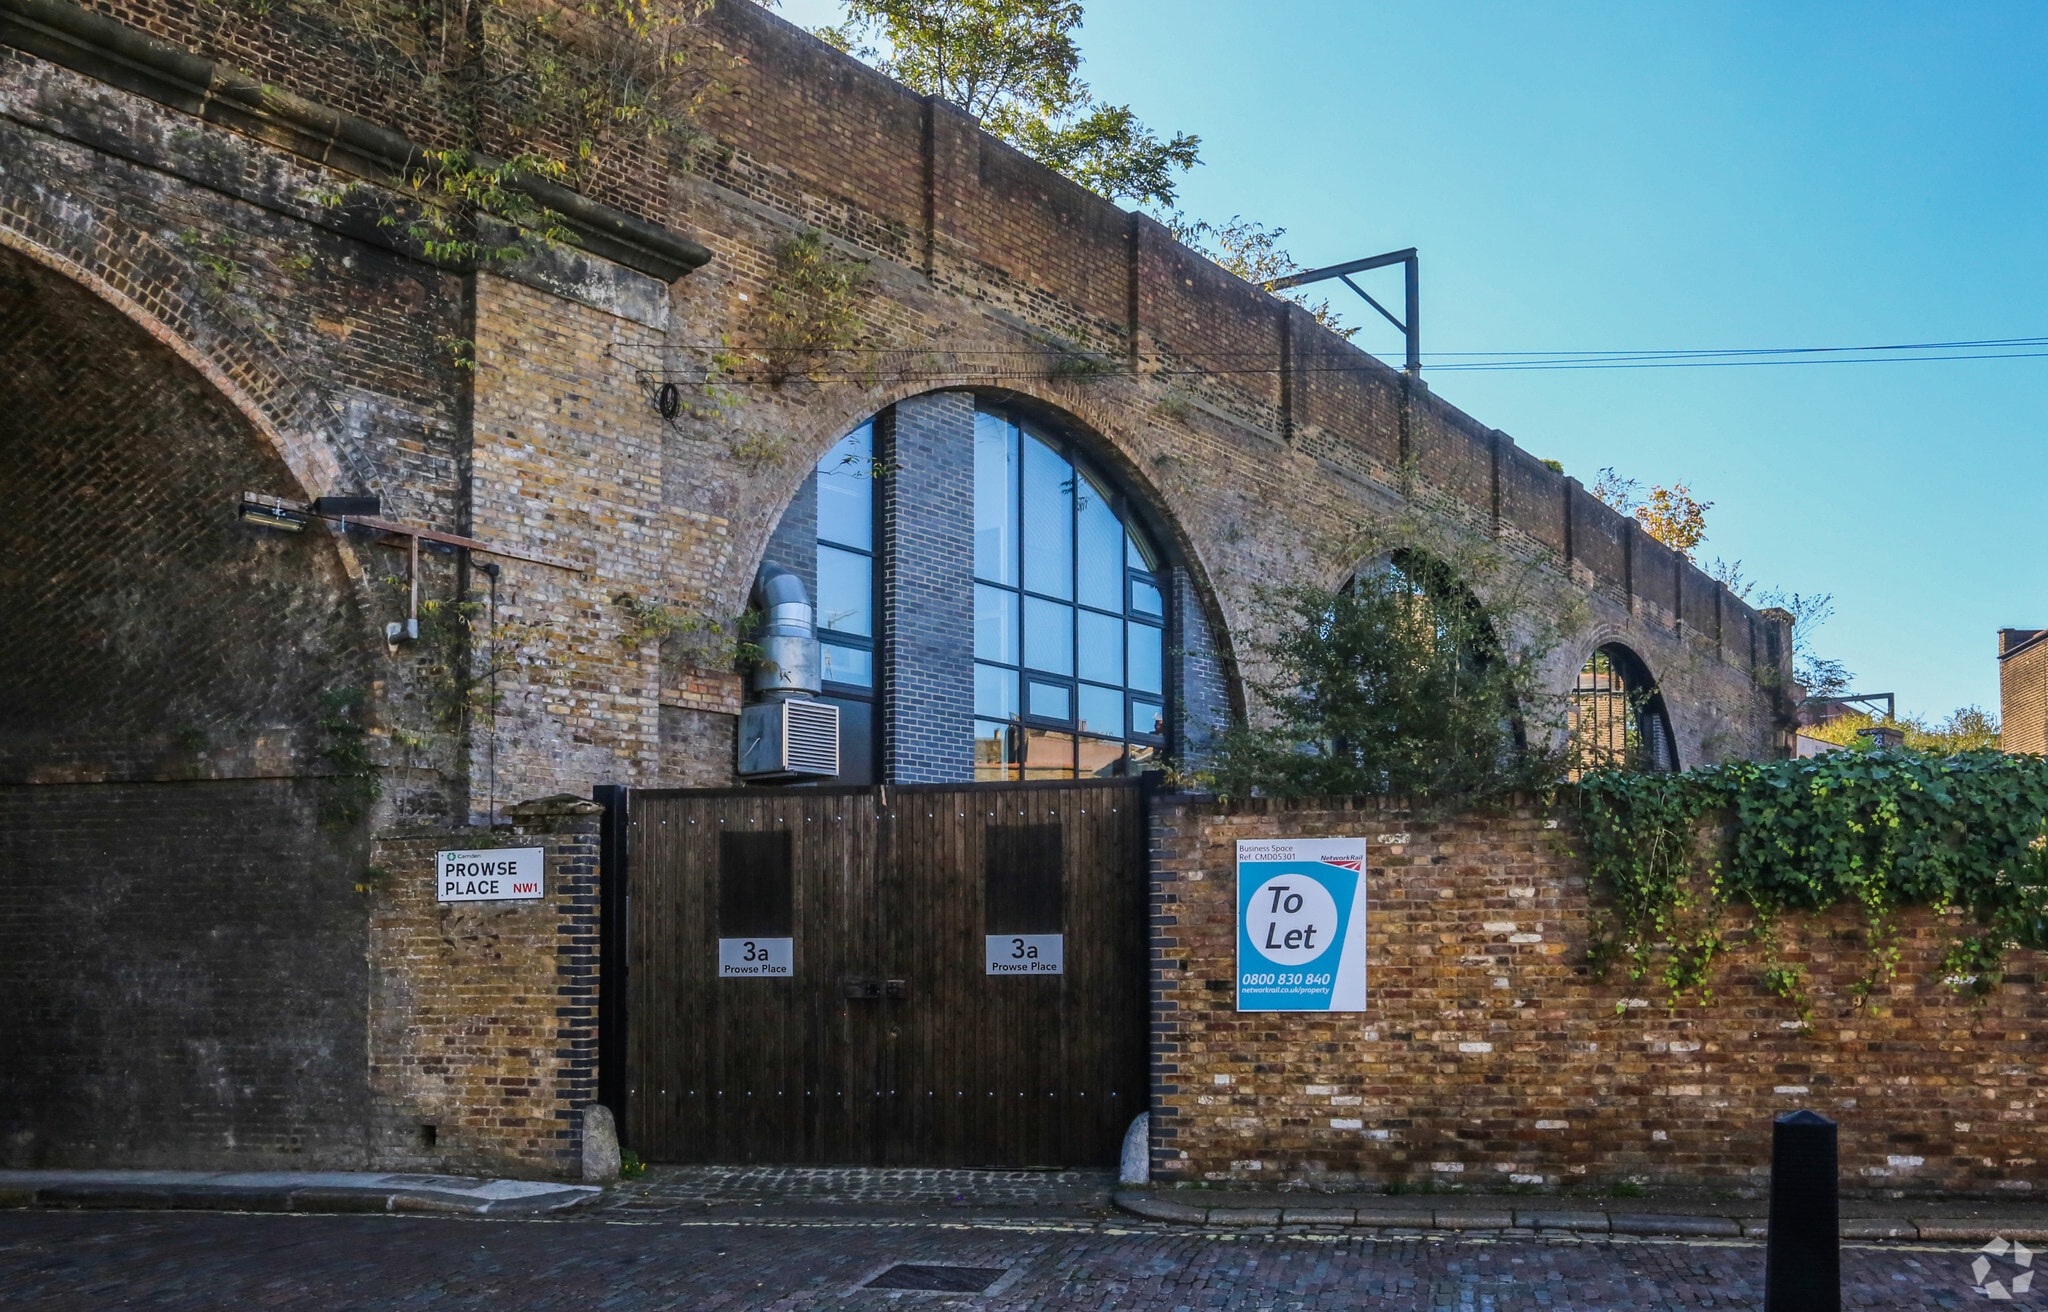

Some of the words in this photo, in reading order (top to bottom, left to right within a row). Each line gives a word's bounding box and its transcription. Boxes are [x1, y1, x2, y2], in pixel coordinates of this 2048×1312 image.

[1271, 845, 1293, 853] Space
[1254, 853, 1296, 861] CMD05301
[445, 861, 517, 877] PROWSE
[445, 880, 499, 895] PLACE
[513, 883, 538, 893] NW1
[1267, 886, 1303, 914] To
[1265, 922, 1317, 950] Let
[743, 941, 769, 961] 3a
[1011, 938, 1038, 959] 3a
[724, 964, 759, 973] Prowse
[761, 964, 787, 973] Place
[992, 962, 1028, 971] Prowse
[1031, 961, 1057, 971] Place
[1242, 973, 1275, 985] 0800
[1277, 973, 1303, 985] 830
[1305, 973, 1331, 985] 840
[1241, 986, 1330, 995] networkrail.co.uk/property
